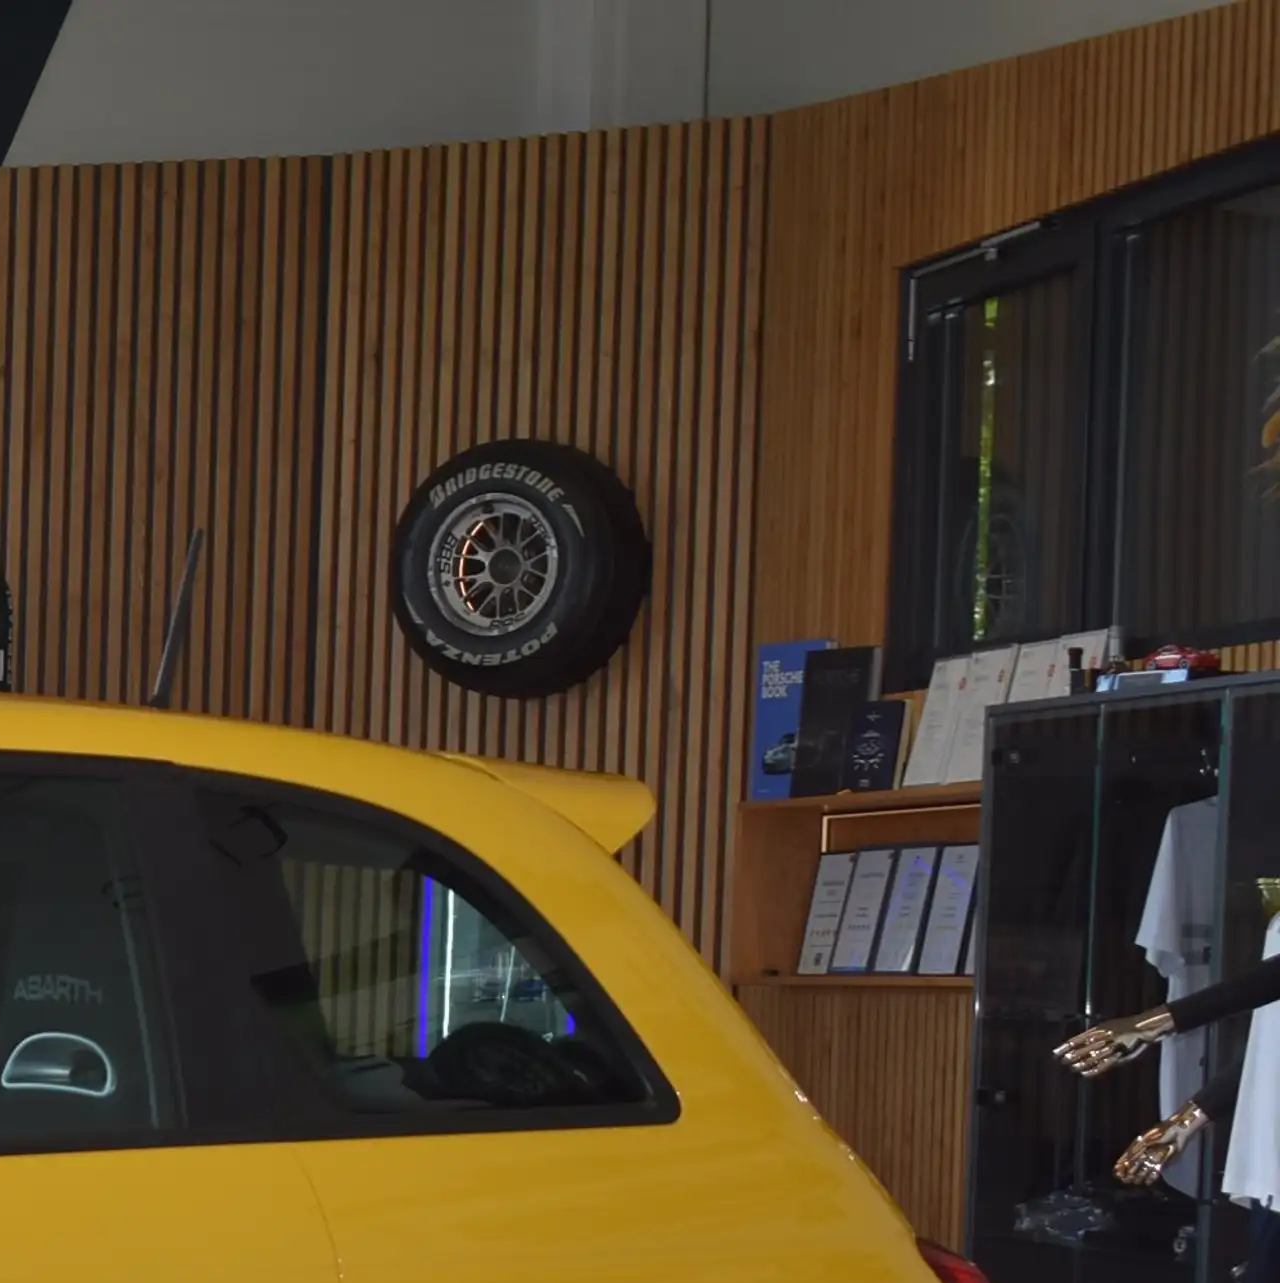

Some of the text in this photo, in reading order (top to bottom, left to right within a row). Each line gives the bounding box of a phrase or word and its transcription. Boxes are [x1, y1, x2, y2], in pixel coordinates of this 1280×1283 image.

[429, 462, 565, 508] BRIDGESTONE
[426, 622, 559, 666] POTENZA
[761, 660, 781, 674] THE
[761, 670, 805, 686] PORSCHE
[761, 684, 788, 699] BOOK
[13, 975, 104, 1004] ABARTH
